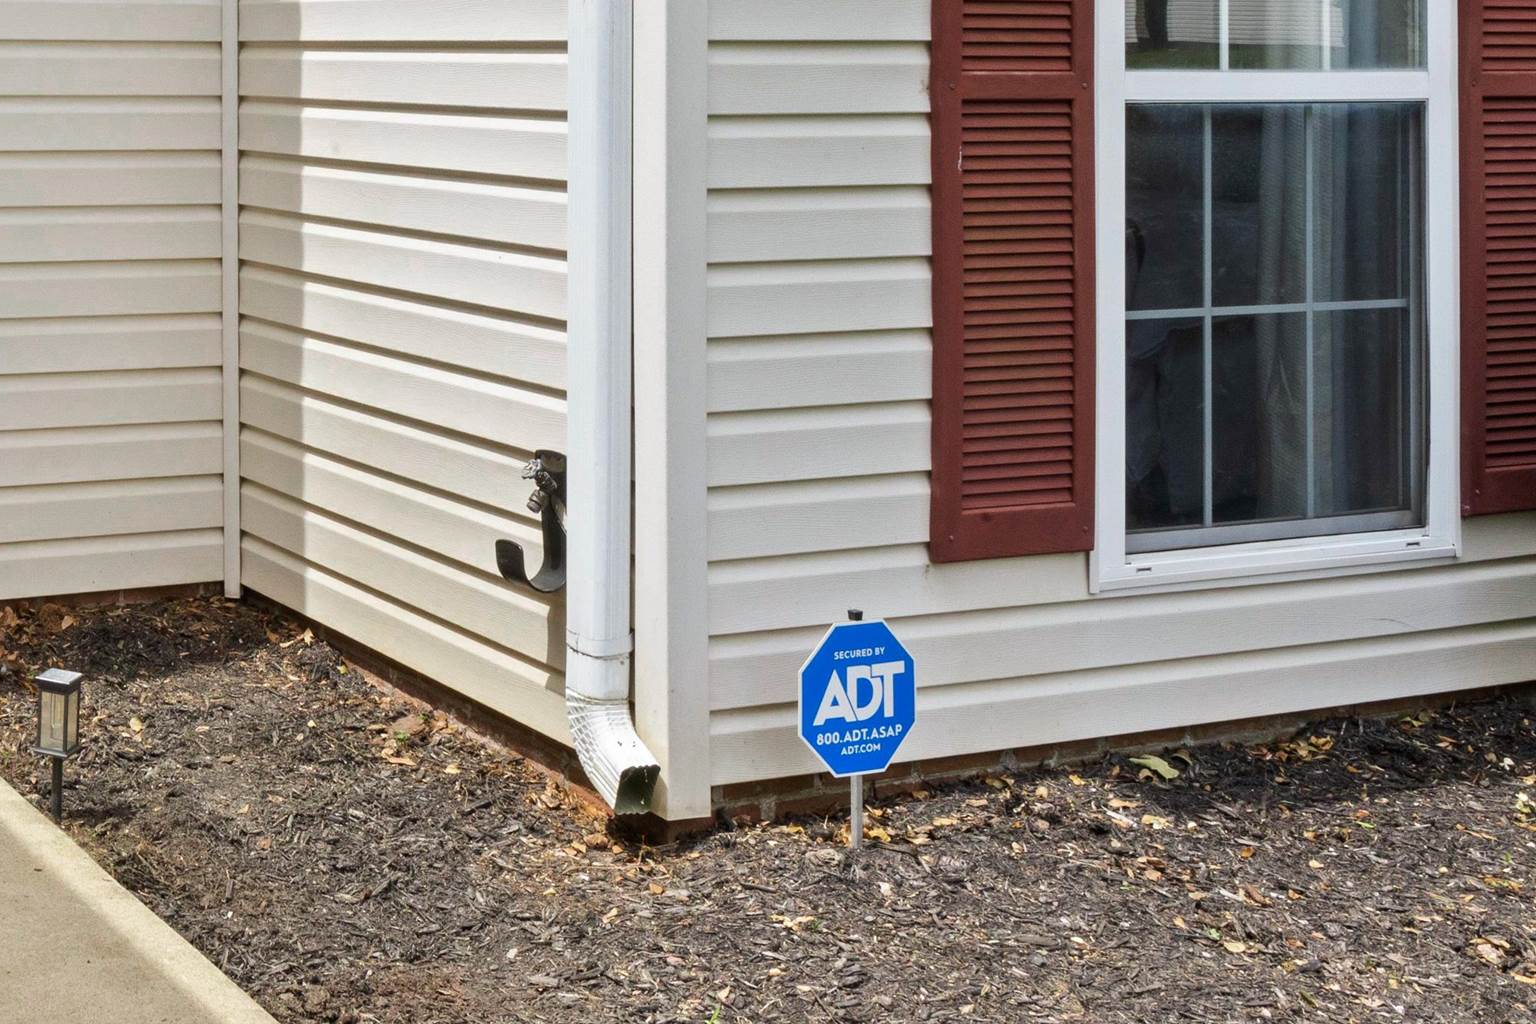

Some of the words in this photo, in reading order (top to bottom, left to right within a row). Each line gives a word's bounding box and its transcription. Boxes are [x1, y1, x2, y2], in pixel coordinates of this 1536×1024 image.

[834, 648, 873, 660] SECURED
[874, 647, 885, 657] BY
[813, 660, 905, 726] ADT
[816, 724, 903, 746] 800.ADT.ASAP
[840, 743, 881, 756] ADT.COM
